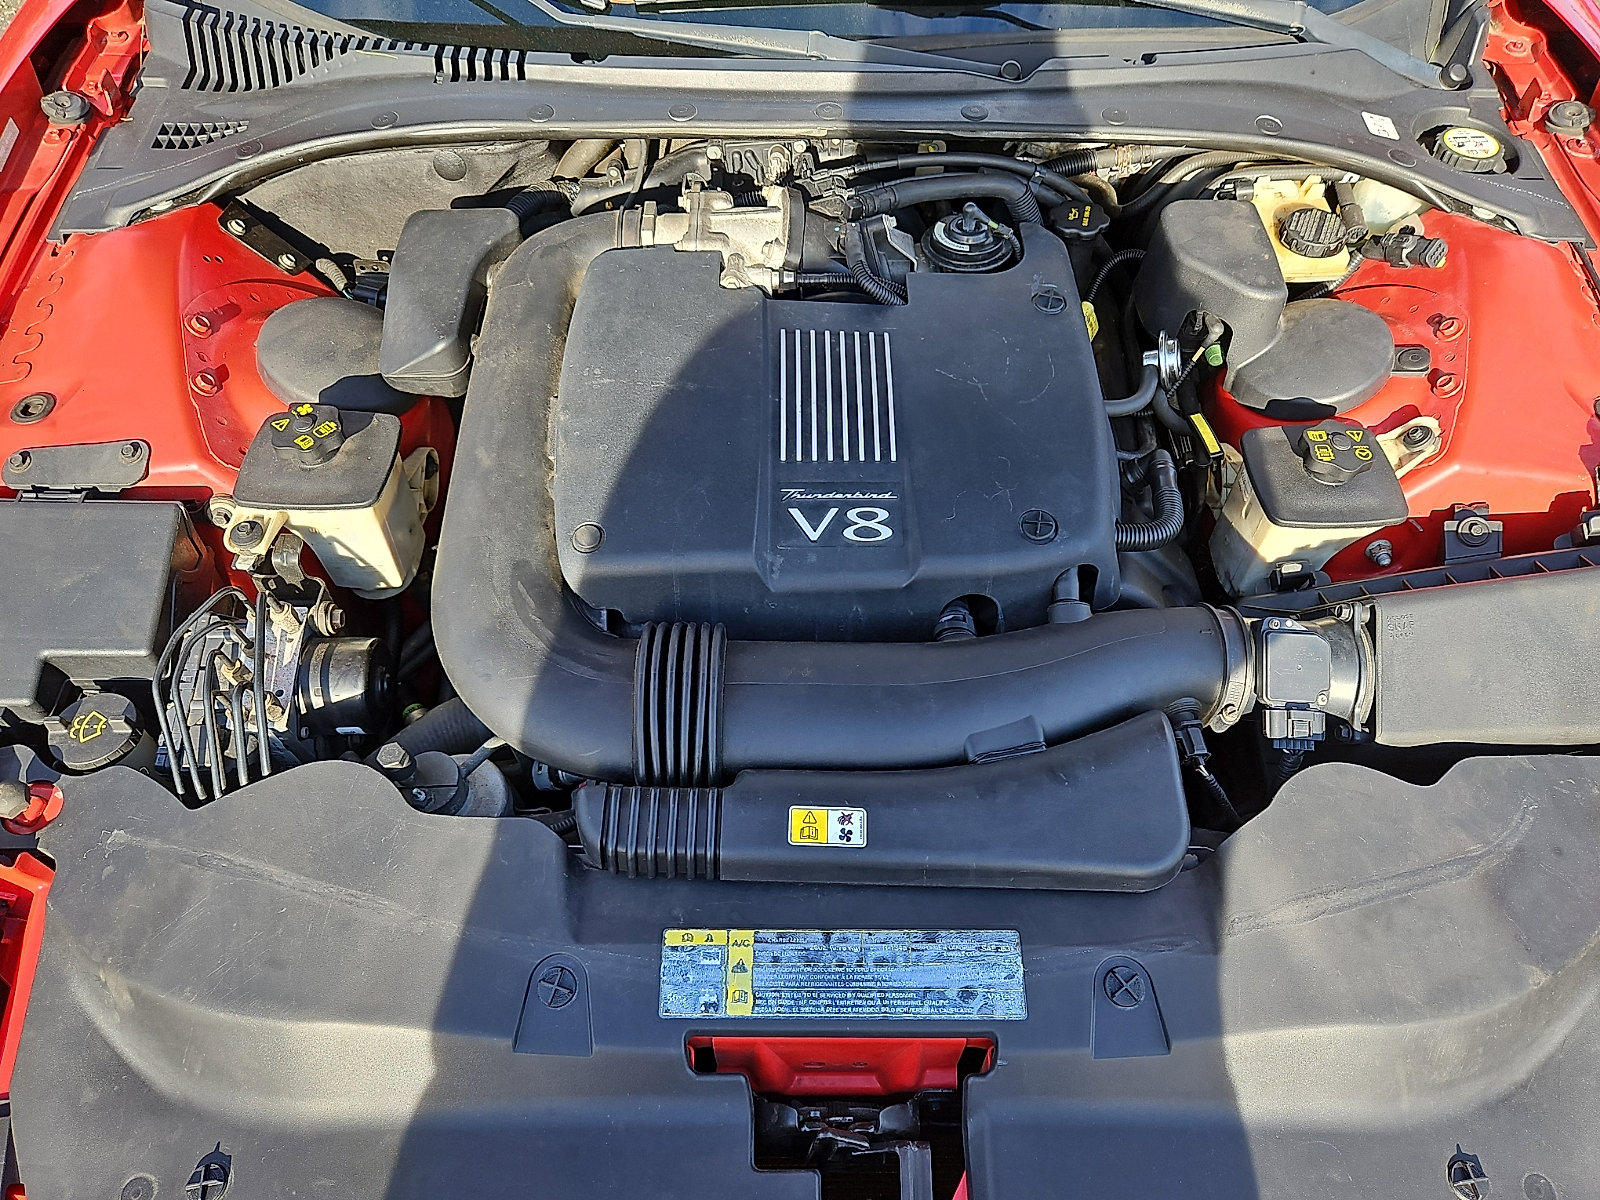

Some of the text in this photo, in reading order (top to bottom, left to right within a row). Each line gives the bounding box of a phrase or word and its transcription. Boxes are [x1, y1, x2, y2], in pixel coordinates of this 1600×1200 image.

[780, 488, 898, 501] Thunderbird
[787, 507, 893, 541] V8
[732, 939, 750, 947] A/C
